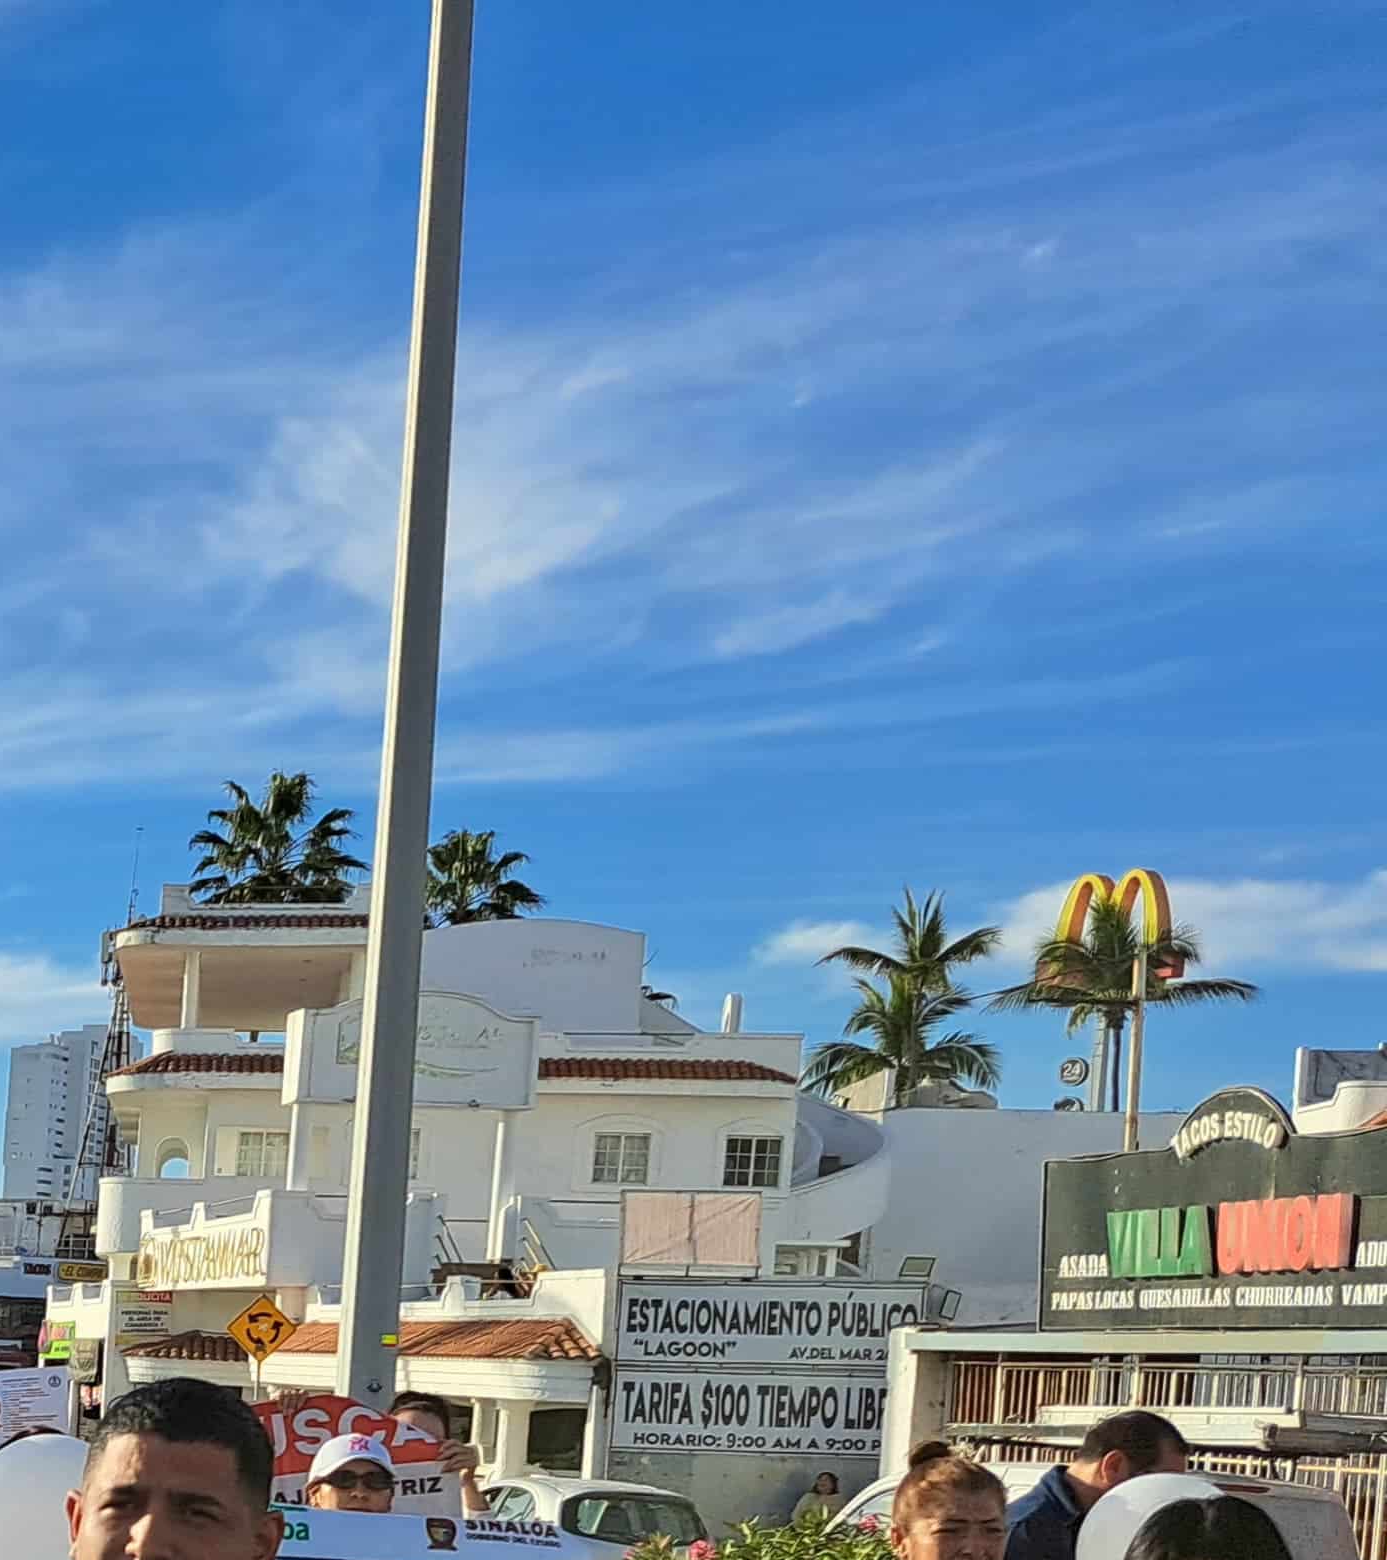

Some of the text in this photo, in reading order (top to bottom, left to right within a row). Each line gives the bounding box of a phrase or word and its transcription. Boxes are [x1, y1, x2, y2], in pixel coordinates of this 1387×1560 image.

[1062, 1062, 1081, 1077] 24
[1173, 1111, 1276, 1160] TACOS ESTILO
[1106, 1205, 1211, 1279] VILLA
[1051, 1292, 1093, 1311] PAPAS
[1094, 1290, 1135, 1309] LOCAS
[1138, 1286, 1231, 1308] QUESADILLAS
[1235, 1285, 1334, 1307] CHURREADAS
[626, 1298, 822, 1336] ESTACIONAMIENTO
[839, 1348, 874, 1361] MAR
[622, 1381, 694, 1425] TARIFA
[701, 1379, 751, 1430] $100
[756, 1384, 839, 1430] TIEMPO
[633, 1432, 723, 1448] HORARIO:
[726, 1433, 767, 1449] 9:00
[772, 1437, 802, 1450] AM
[805, 1437, 821, 1450] A
[825, 1438, 866, 1452] 9:00
